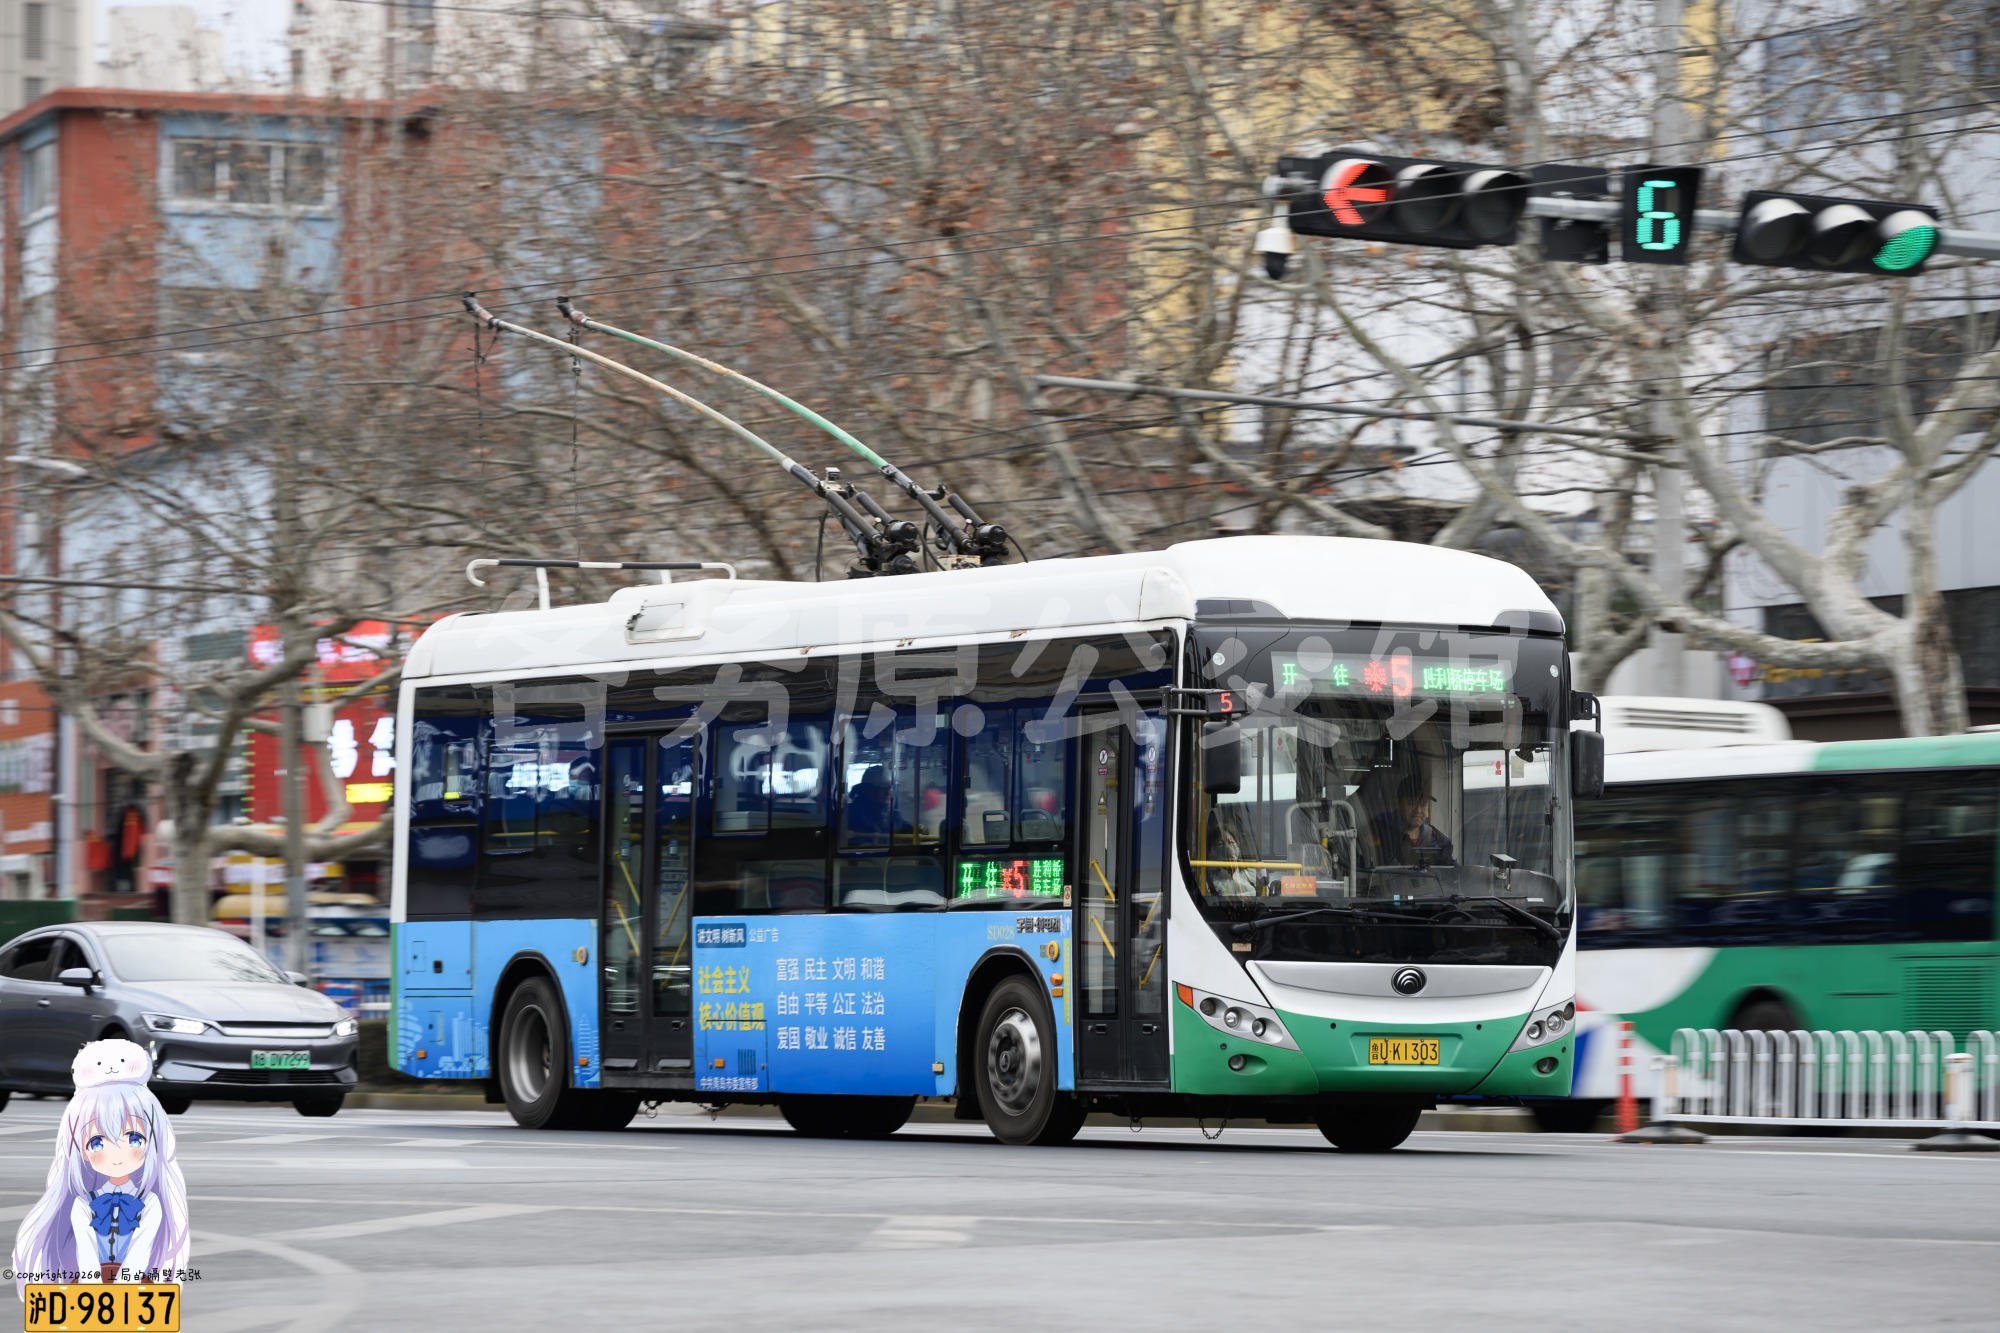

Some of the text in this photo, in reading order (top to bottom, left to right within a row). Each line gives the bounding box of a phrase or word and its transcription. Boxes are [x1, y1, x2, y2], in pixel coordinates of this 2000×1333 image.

[1636, 180, 1681, 251] 6
[1282, 656, 1504, 697] 开 往 5 胜利桥停车场
[1220, 692, 1233, 712] 5
[1013, 860, 1025, 898] 5
[749, 927, 779, 943] 公益广告
[698, 966, 751, 994] 社会主义
[776, 957, 885, 981] 富强 民主 文明 和谐
[699, 1002, 765, 1031] 核心价值观
[777, 992, 885, 1016] 自由 平等 公正 法治
[777, 1026, 886, 1051] 爱国 敬业 诚信 友善
[1371, 1042, 1438, 1061] 鲁U·K1303
